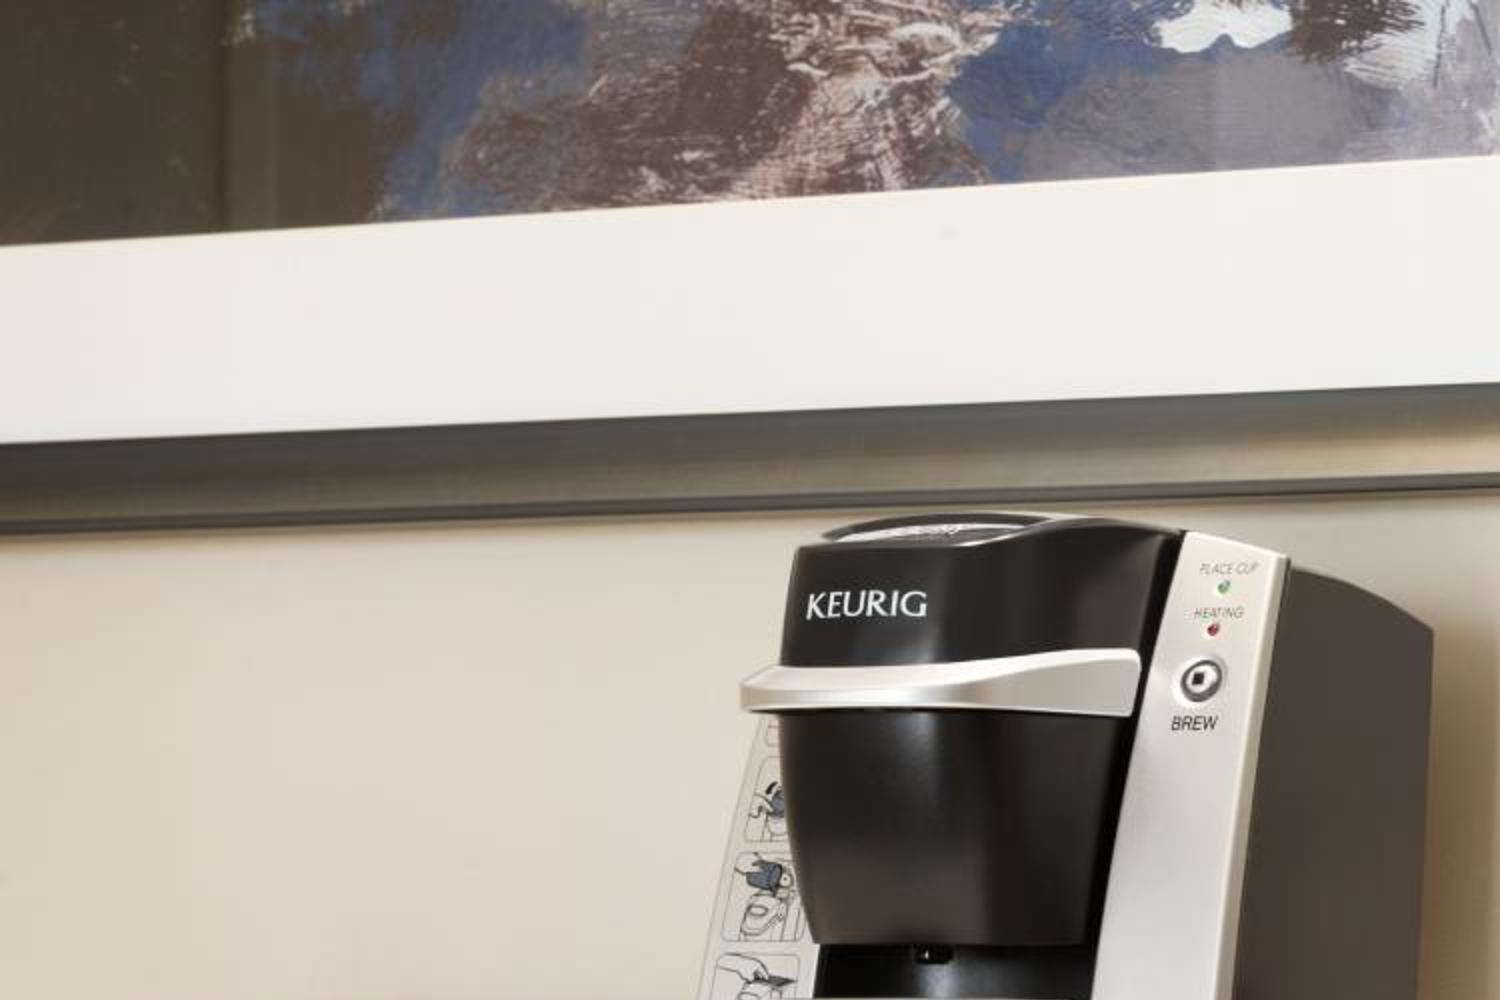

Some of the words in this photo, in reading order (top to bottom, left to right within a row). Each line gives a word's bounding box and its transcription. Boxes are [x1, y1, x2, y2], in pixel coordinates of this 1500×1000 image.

[1200, 563, 1232, 575] PLACE
[1235, 562, 1259, 574] CUP
[806, 589, 927, 620] KEURIG
[1194, 607, 1244, 618] HEATING
[1171, 715, 1218, 731] BREW
